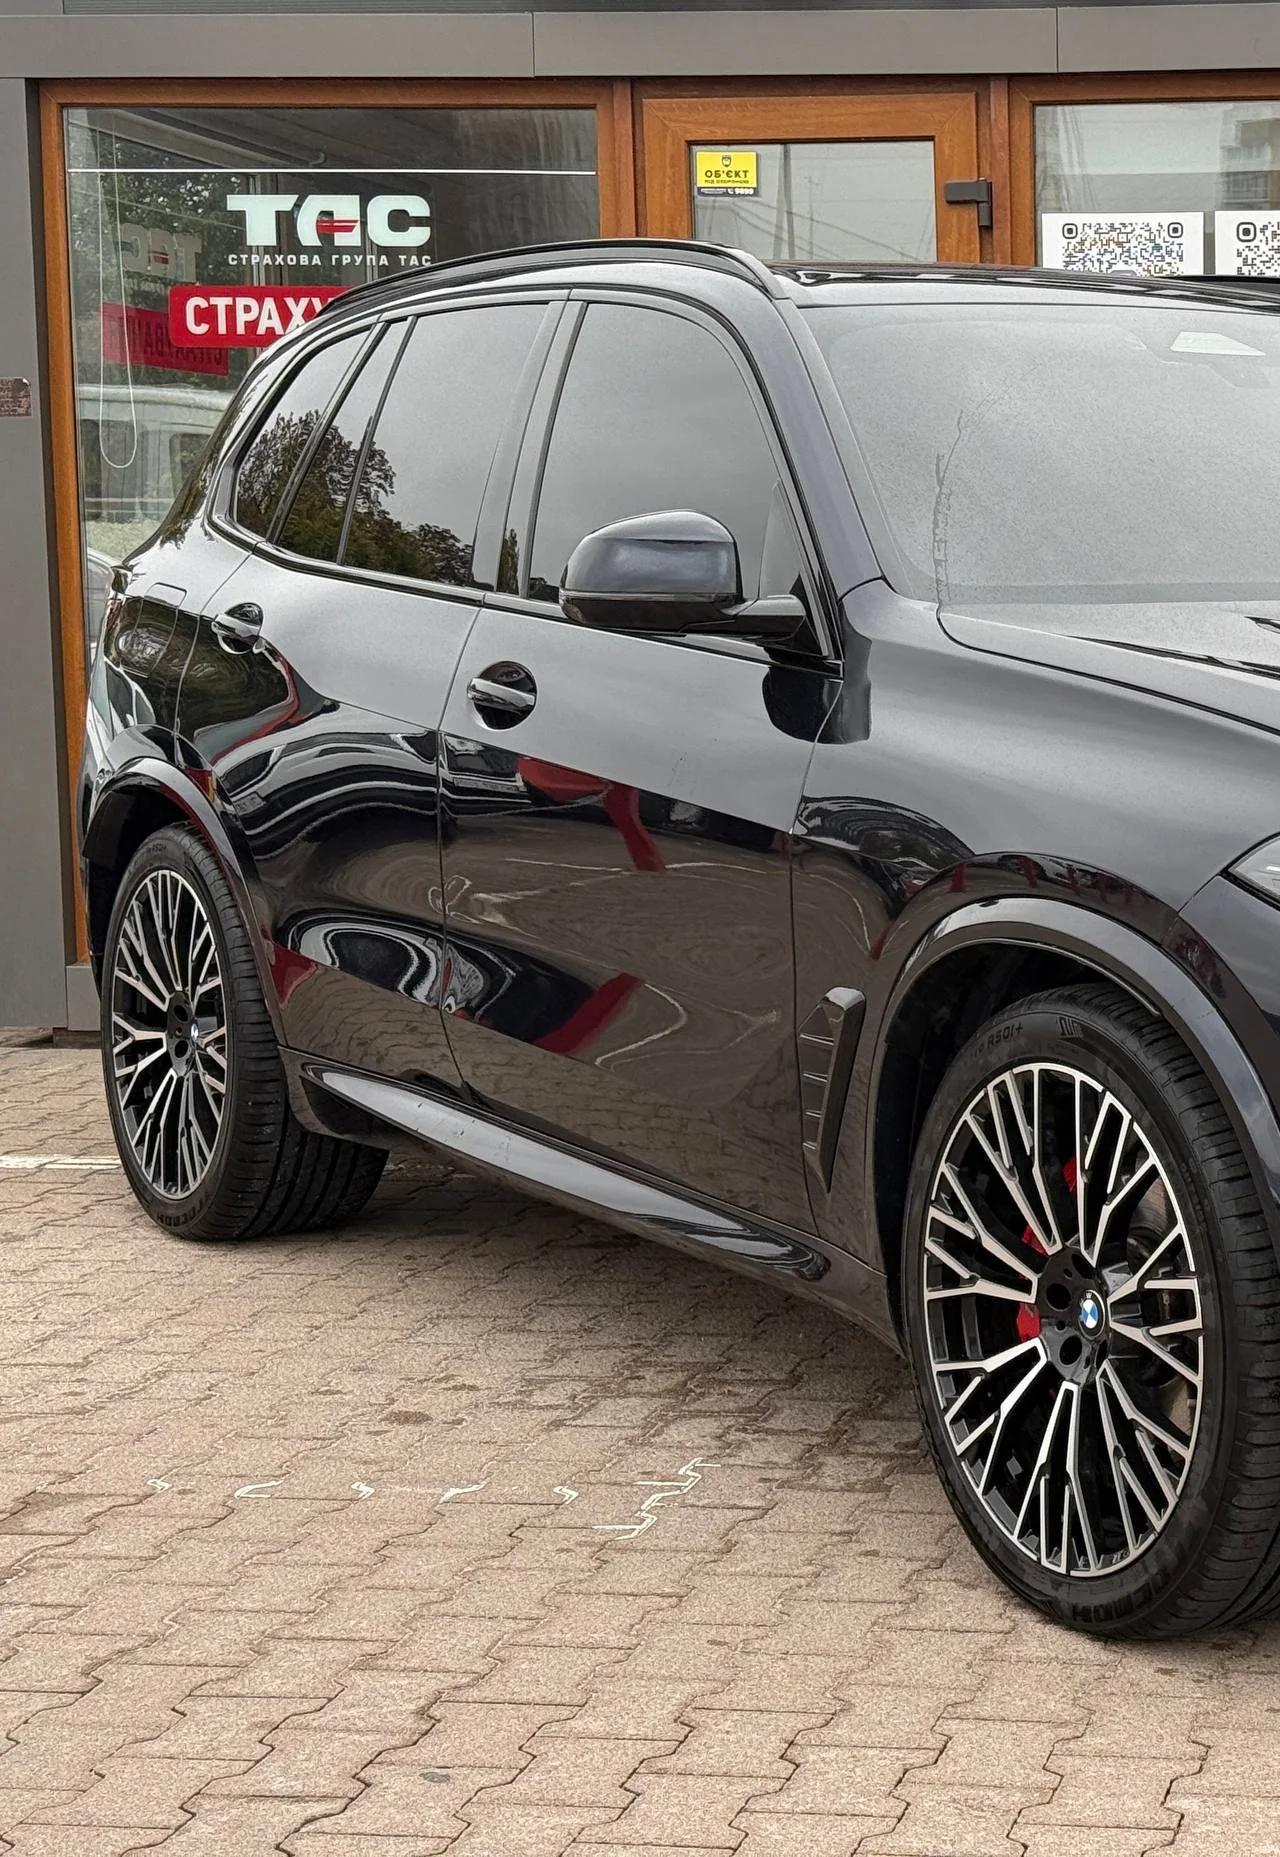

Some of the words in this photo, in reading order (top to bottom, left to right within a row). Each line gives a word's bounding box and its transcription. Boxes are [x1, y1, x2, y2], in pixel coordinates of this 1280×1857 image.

[704, 169, 750, 179] ОБ'ЄКТ
[226, 194, 431, 247] ТАС
[228, 253, 322, 267] СТРАХОВА
[331, 254, 390, 267] ГРУПА
[398, 254, 433, 267] ТАС
